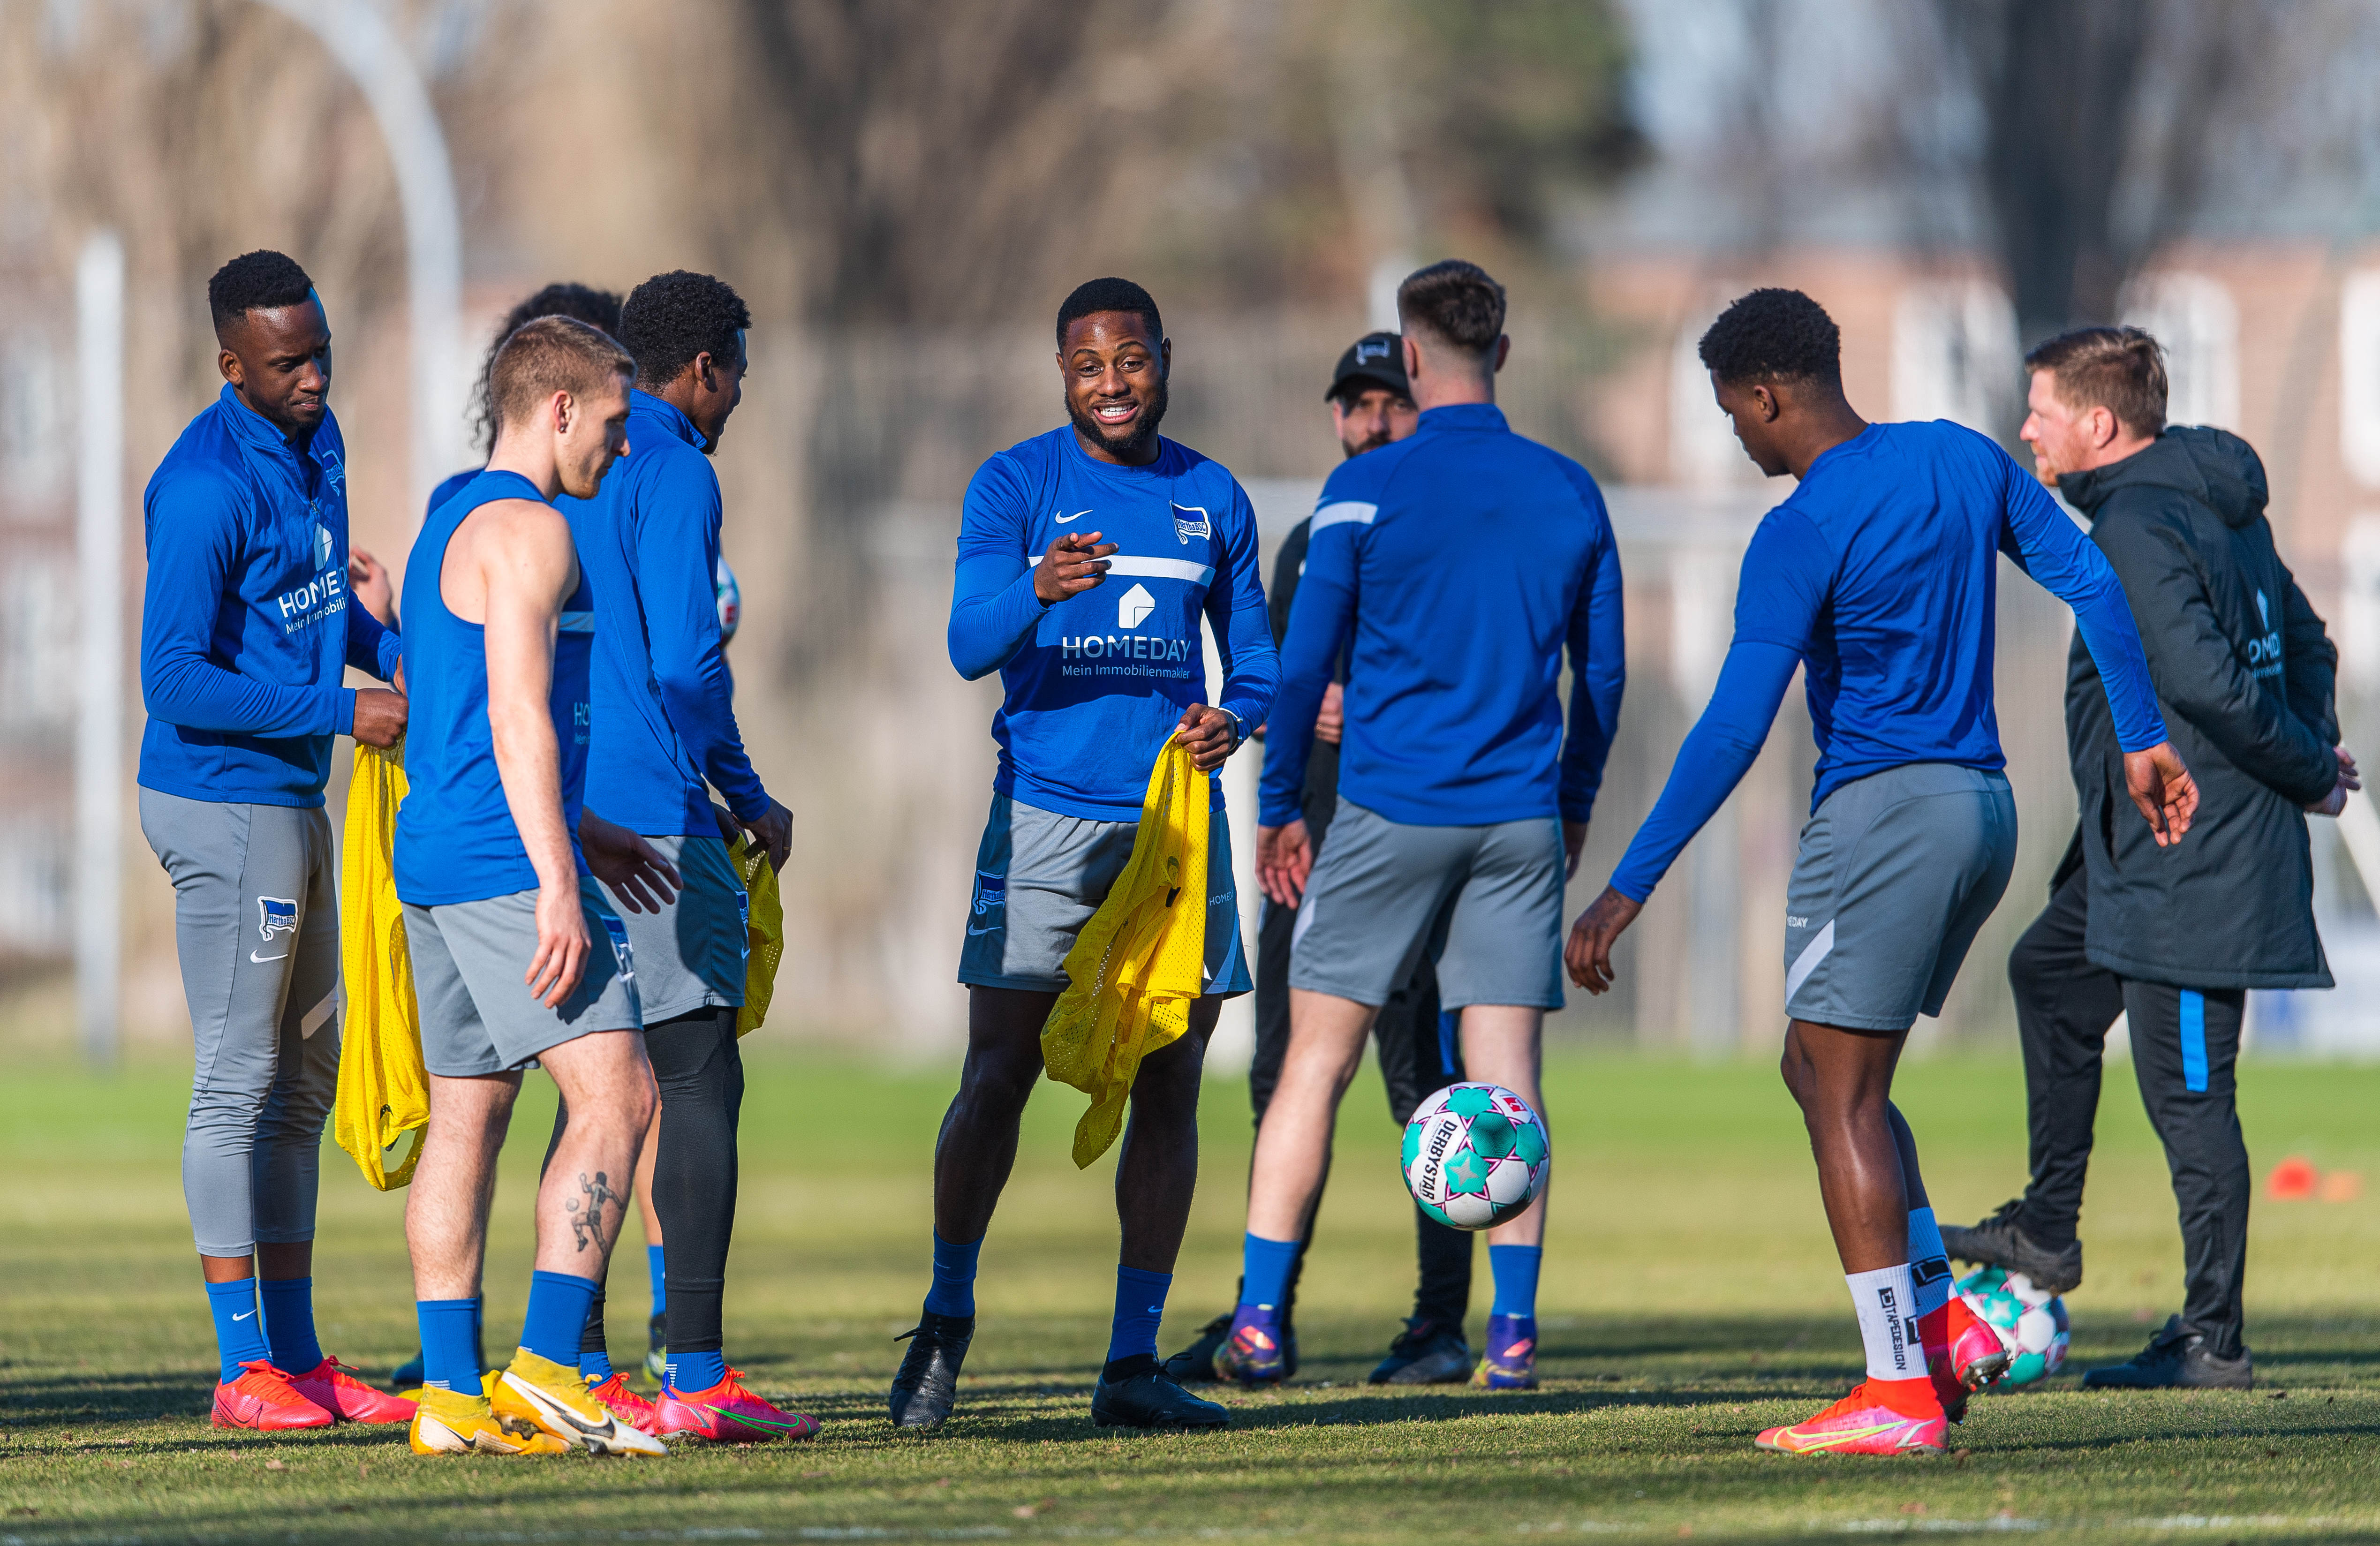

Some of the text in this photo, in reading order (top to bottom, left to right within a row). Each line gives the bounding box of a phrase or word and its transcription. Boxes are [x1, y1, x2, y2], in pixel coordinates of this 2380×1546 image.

[286, 618, 305, 634] Mein
[1062, 635, 1191, 662] HOMEDAY
[1063, 664, 1190, 679] Mein Immobilienmakler
[1422, 1120, 1458, 1200] DERBYSTAR
